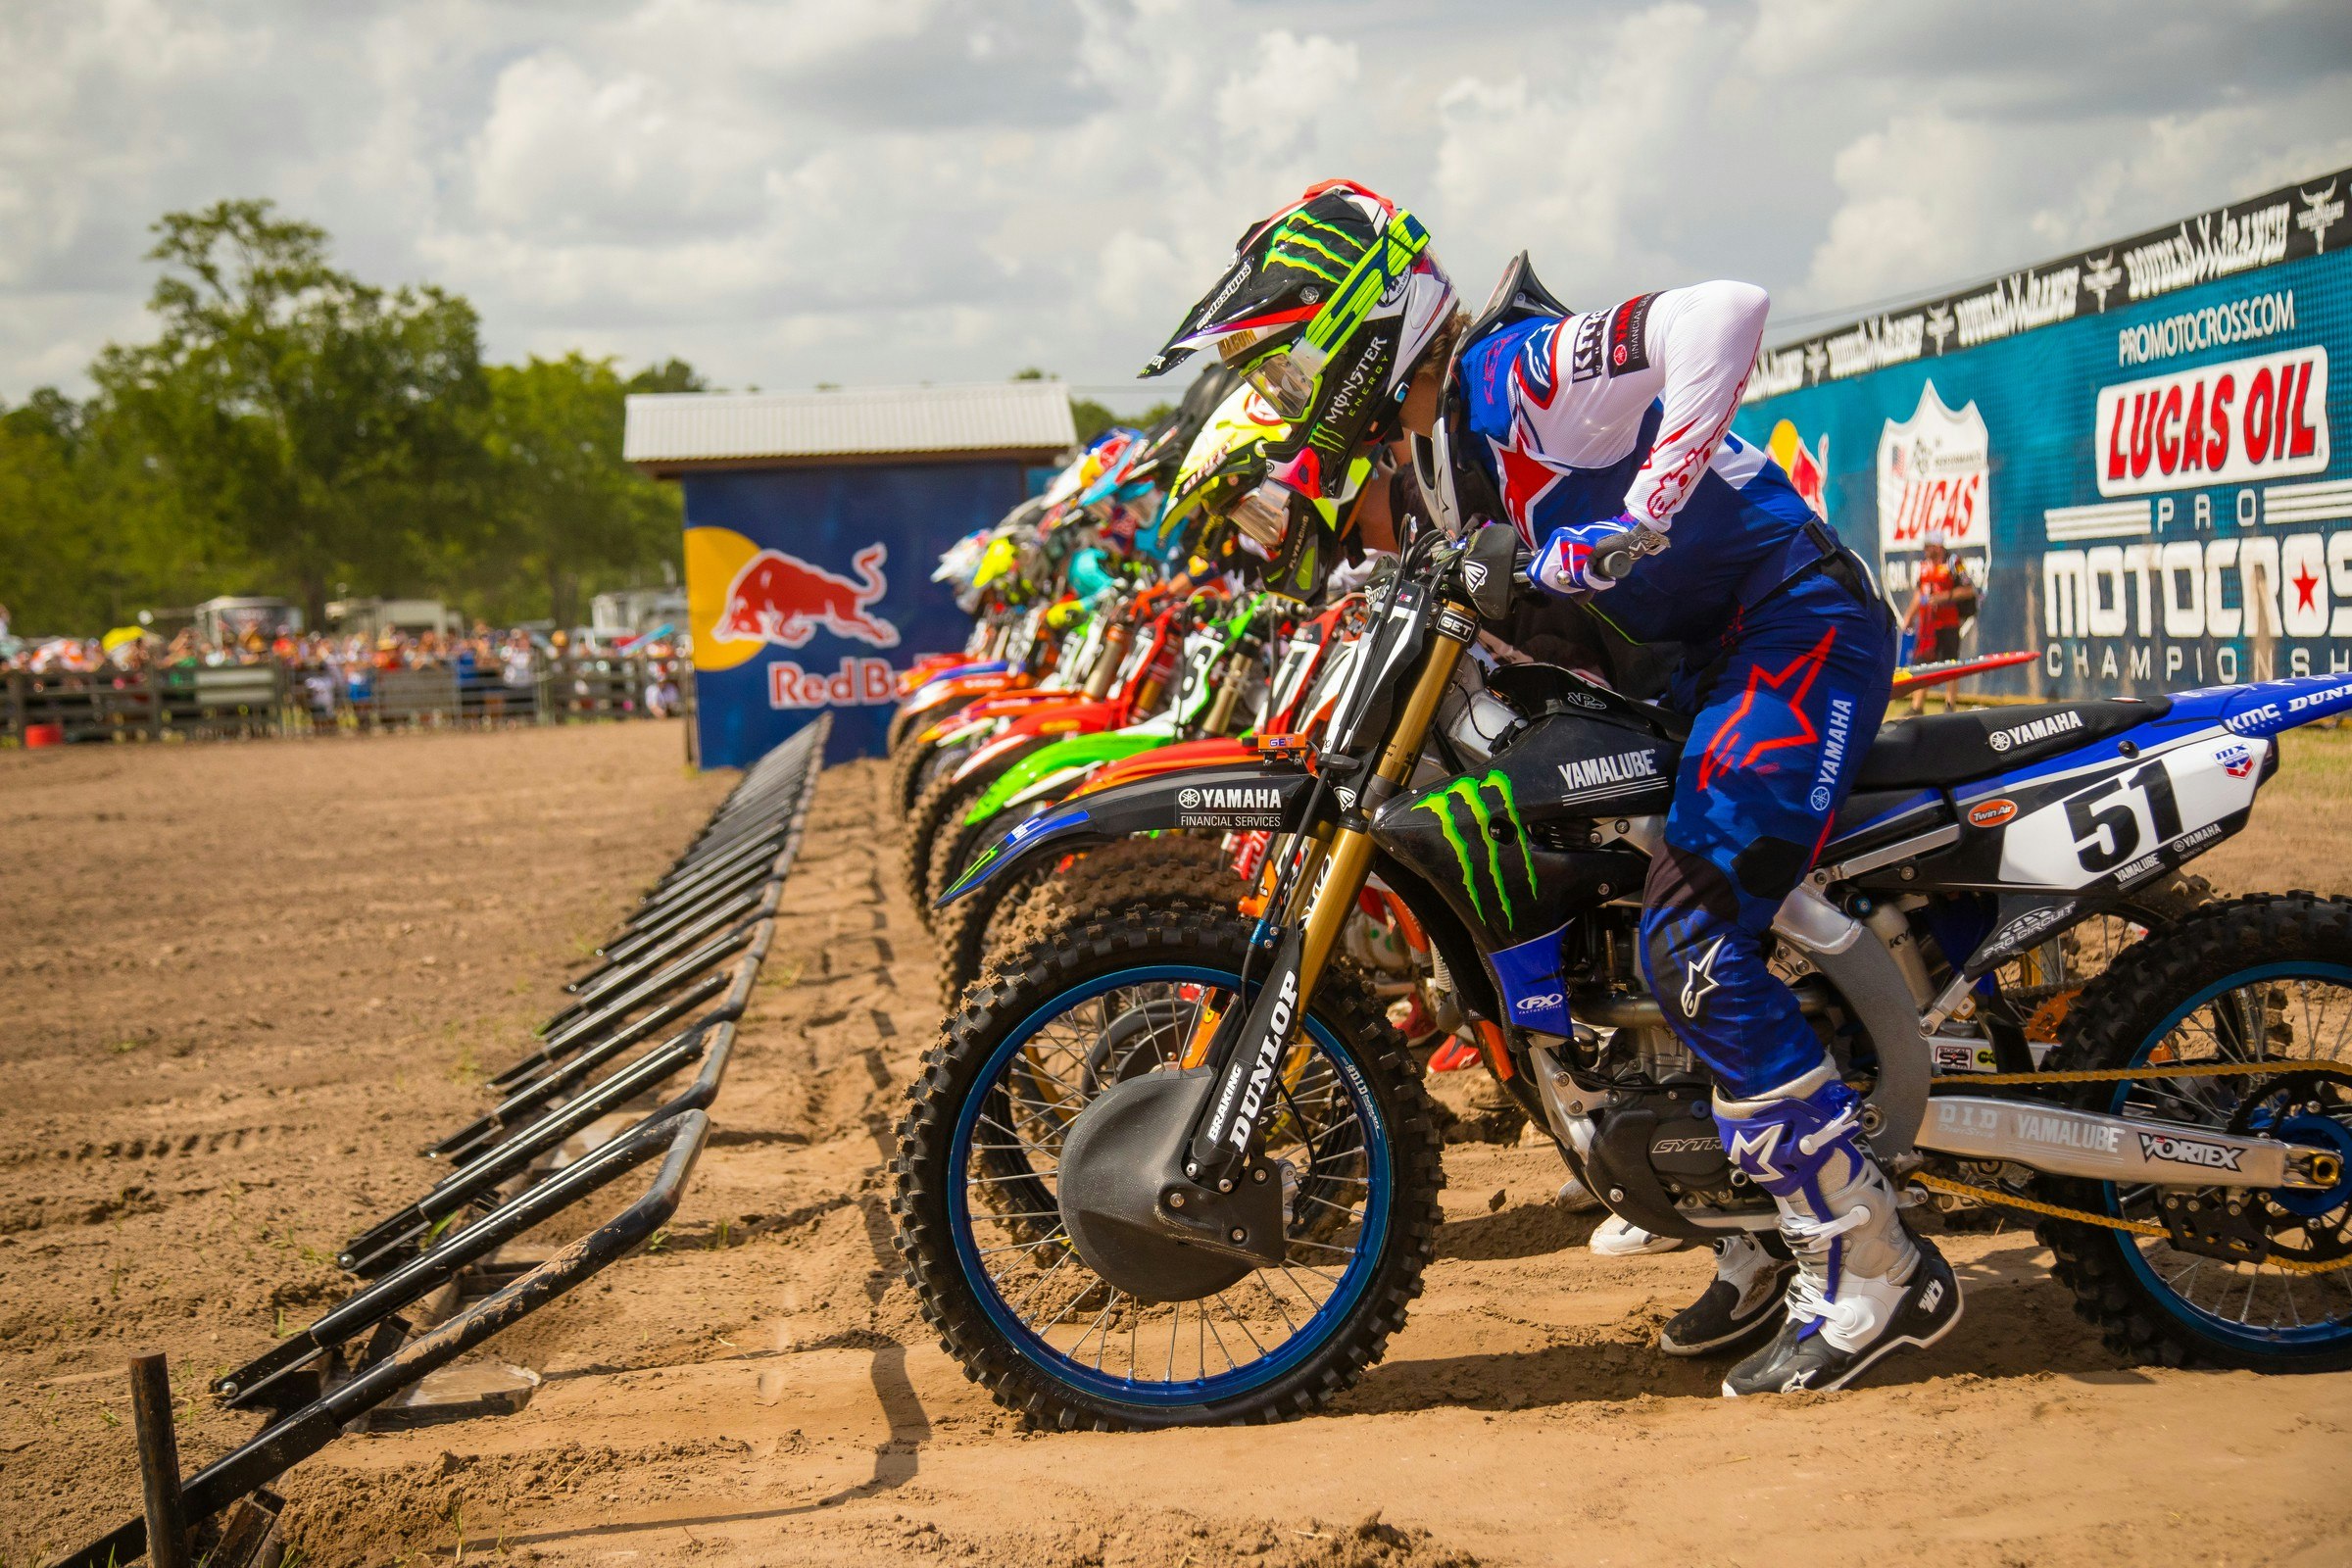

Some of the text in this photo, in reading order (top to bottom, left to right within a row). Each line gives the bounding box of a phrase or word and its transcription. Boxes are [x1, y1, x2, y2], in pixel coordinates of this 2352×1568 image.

[1325, 336, 1388, 423] MONSTER
[1348, 354, 1389, 416] ENERGY
[2108, 361, 2316, 480] LUCAS OIL
[1893, 474, 1980, 540] LUCAS
[2157, 488, 2257, 533] PRO
[1441, 617, 1472, 636] GET
[768, 662, 858, 710] Red
[2007, 710, 2083, 746] YAMAHA
[2225, 704, 2281, 732] KMC
[1269, 737, 1296, 748] GET
[1818, 699, 1852, 785] YAMAHA
[1558, 749, 1658, 790] YAMALUBE
[1201, 788, 1282, 808] YAMAHA
[1973, 805, 2013, 822] Twin Air
[2062, 760, 2183, 873] 51
[1180, 815, 1281, 828] FINANCIAL SERVICES
[2182, 823, 2222, 848] YAMAHA
[2113, 852, 2160, 883] YAMALUBE
[1982, 901, 2077, 960] PRO CIRCUIT
[1229, 969, 1298, 1153] DUNLOP
[1206, 1061, 1244, 1145] BRAKING
[2017, 1113, 2125, 1153] YAMALUBE
[2137, 1132, 2248, 1172] VORTEX
